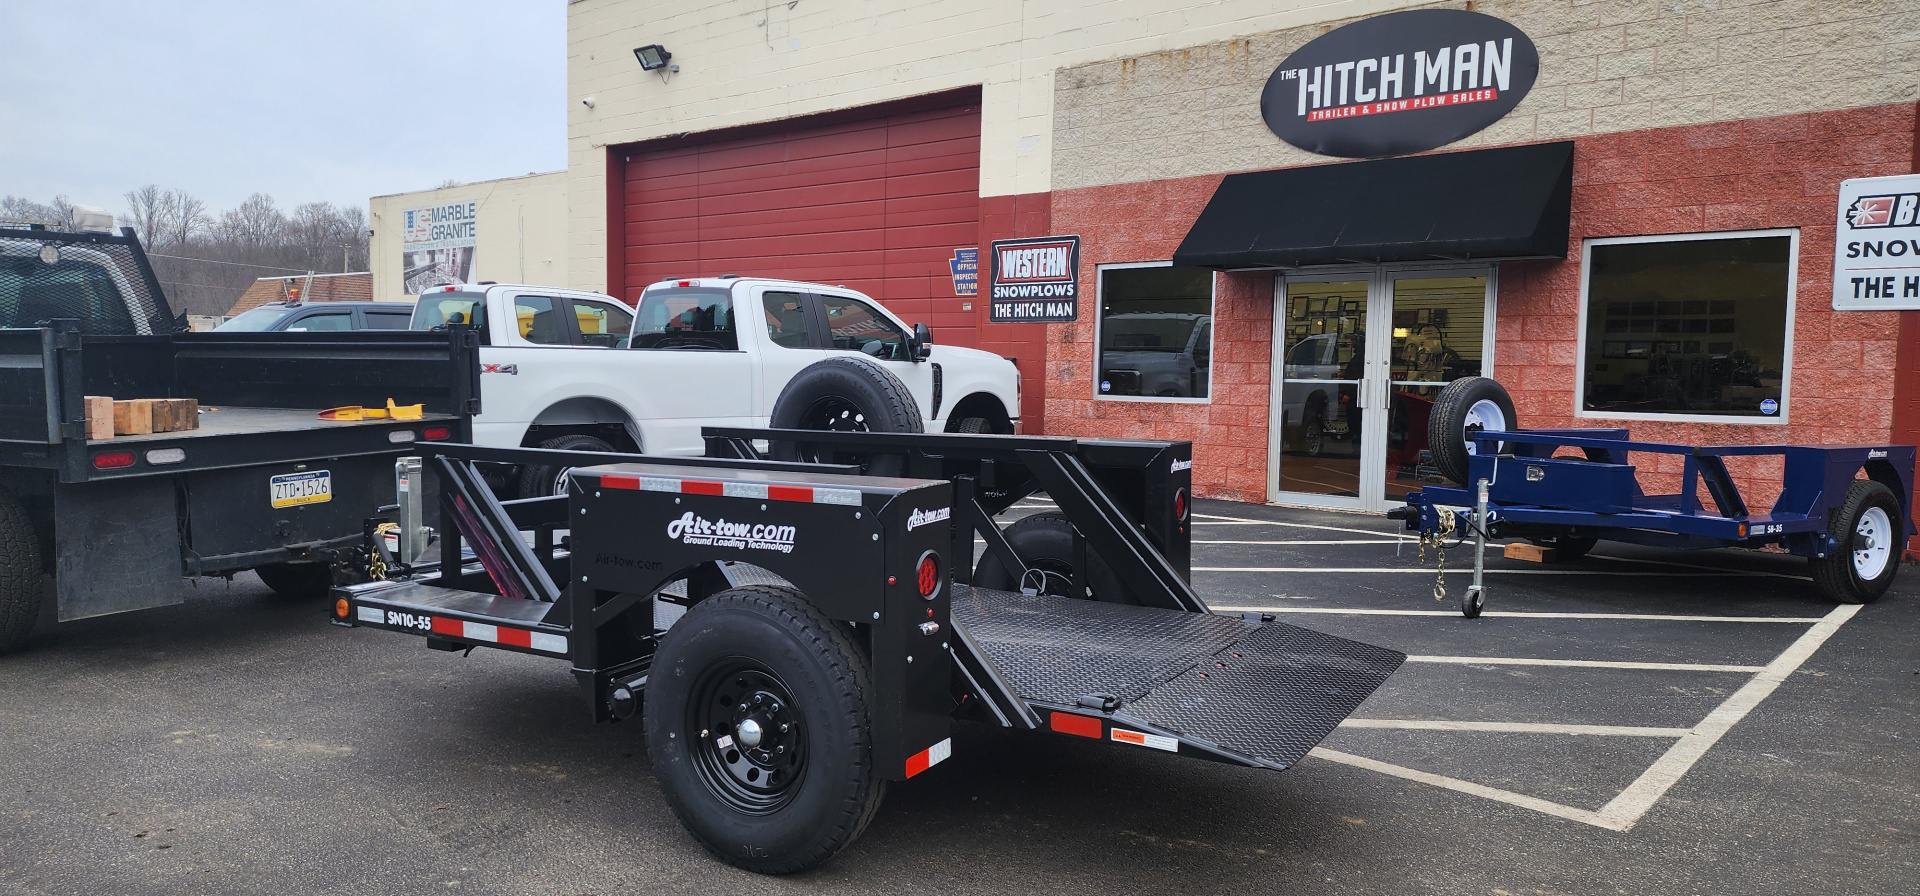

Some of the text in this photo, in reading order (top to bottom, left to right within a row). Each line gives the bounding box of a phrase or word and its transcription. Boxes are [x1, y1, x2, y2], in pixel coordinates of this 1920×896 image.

[1280, 37, 1513, 116] THE HITCH MAN
[1312, 90, 1491, 120] TRAILER & SNOW PLOW SALES
[431, 203, 476, 223] MARBLE
[431, 221, 476, 241] GRANITE
[1002, 246, 1068, 279] WESTERN
[994, 284, 1074, 298] SNOWPLOWS
[1850, 276, 1896, 299] THE
[994, 302, 1073, 318] THE HITCH MAN
[285, 474, 316, 482] PENNSYLVANIA
[667, 511, 796, 541] Air-tow.com
[907, 507, 951, 531] Air-tow.com
[683, 535, 795, 554] Ground Loading Technology
[594, 552, 664, 572] Air-tow.com
[387, 611, 432, 631] SN10-55
